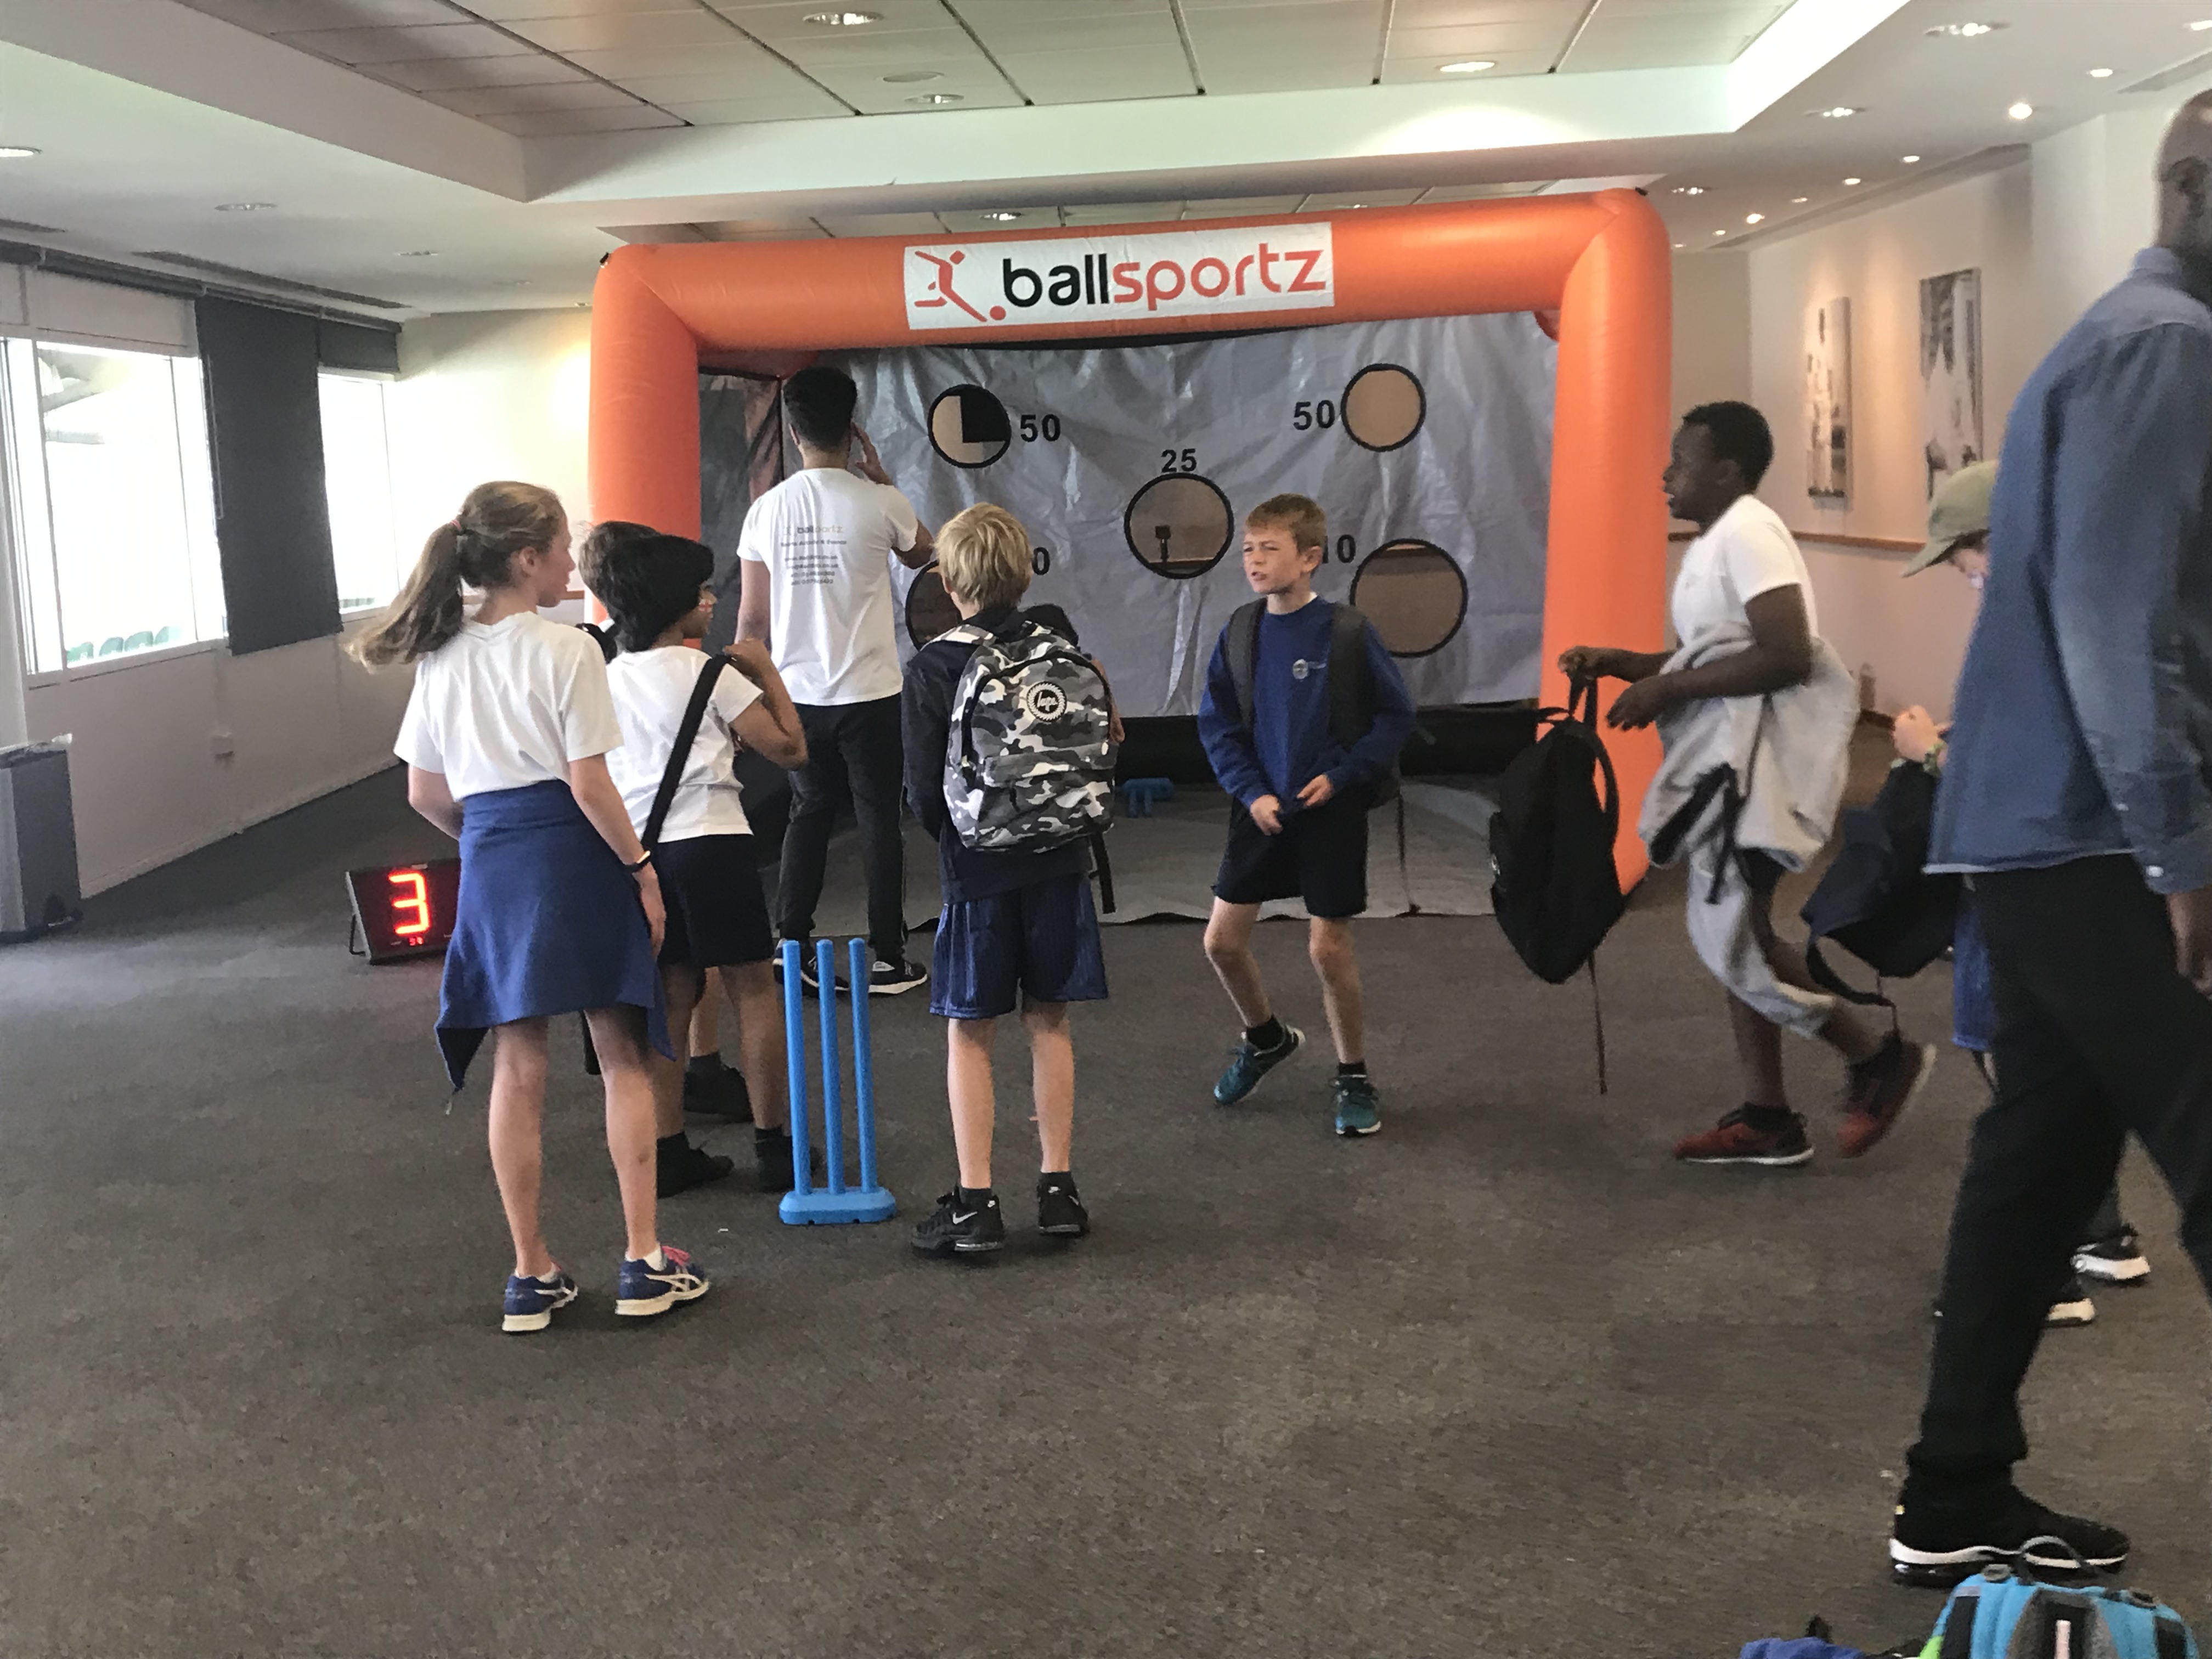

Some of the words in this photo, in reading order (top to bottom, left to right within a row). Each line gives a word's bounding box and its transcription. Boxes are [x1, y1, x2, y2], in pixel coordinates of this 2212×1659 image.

[1002, 243, 1326, 311] ballsportz
[1020, 414, 1060, 442] 50
[1293, 399, 1335, 430] 50
[1161, 448, 1197, 473] 25
[388, 870, 431, 934] 3
